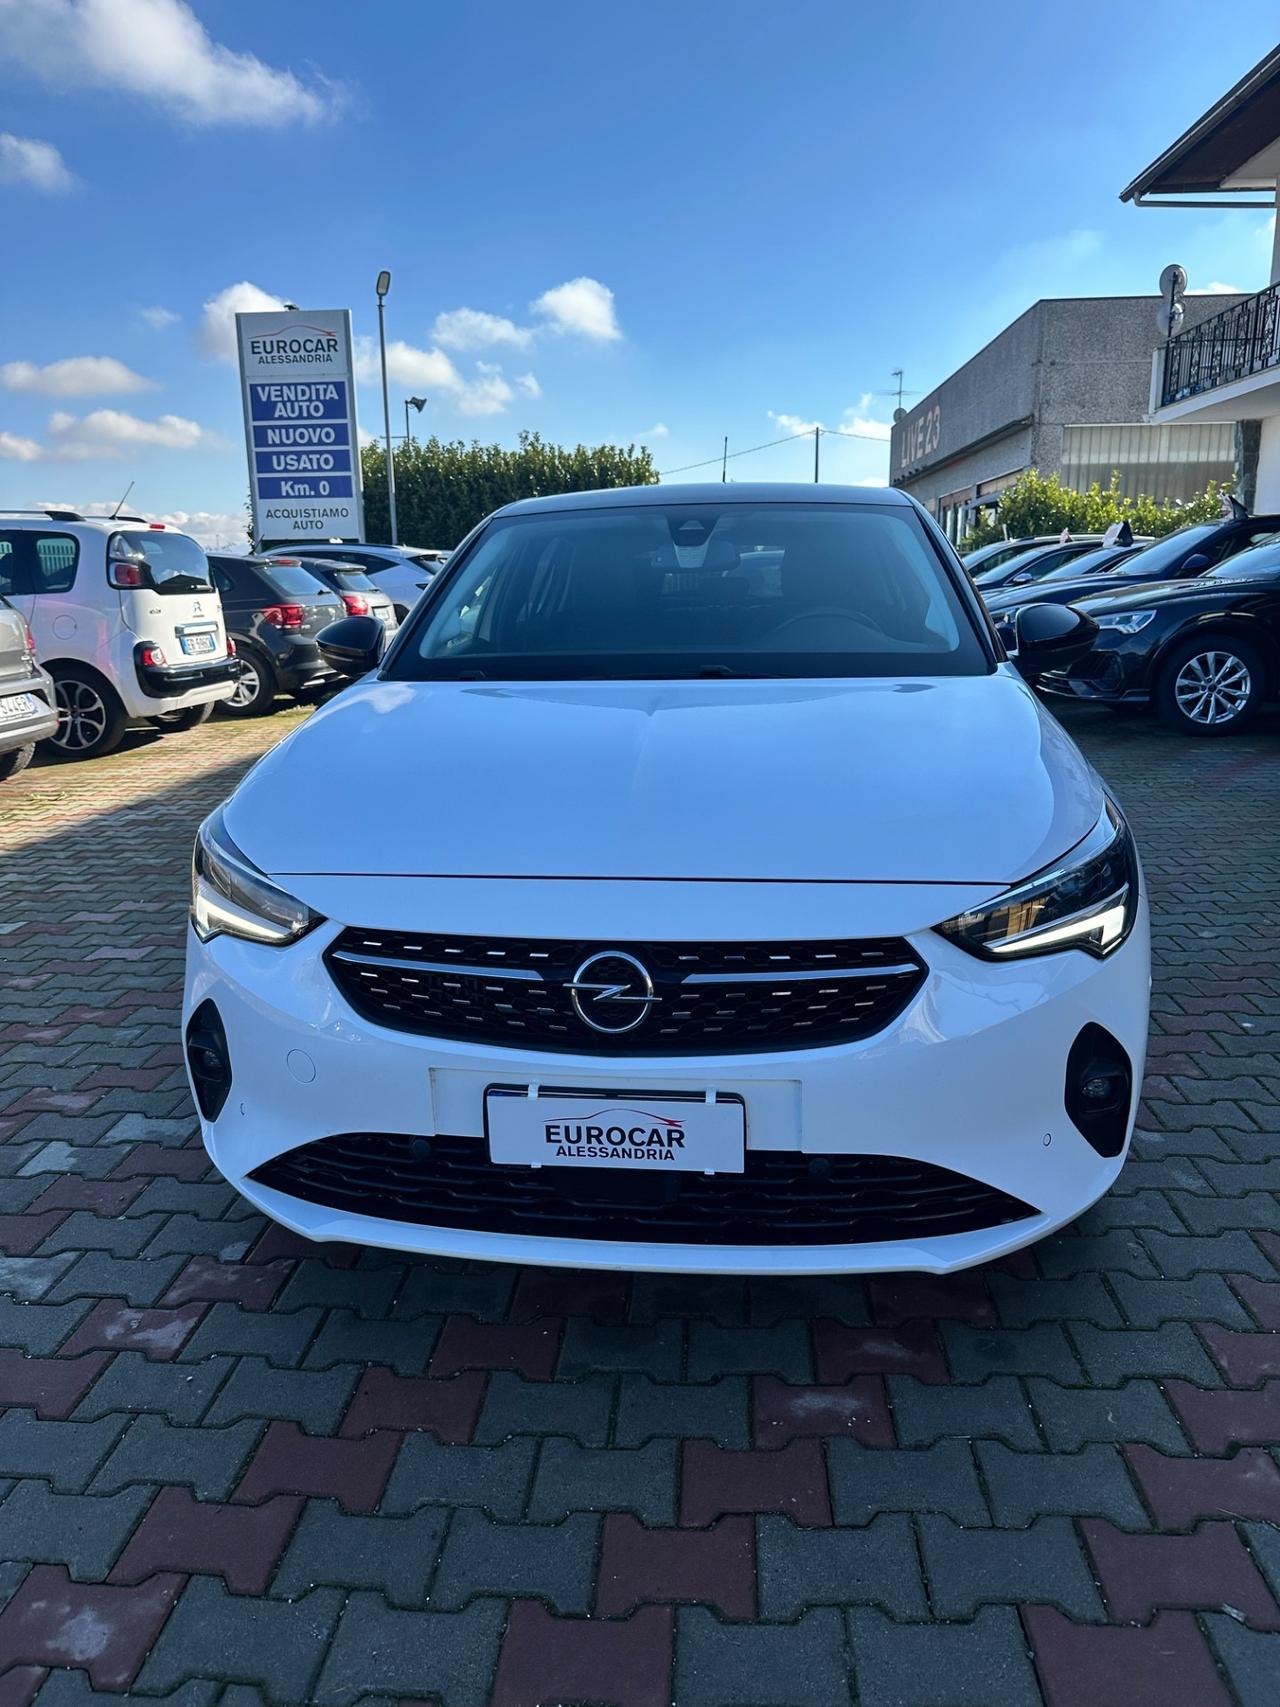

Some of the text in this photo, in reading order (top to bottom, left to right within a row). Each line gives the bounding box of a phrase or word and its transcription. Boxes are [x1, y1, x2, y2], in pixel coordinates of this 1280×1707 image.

[250, 338, 339, 354] EUROCAR
[258, 353, 333, 365] ALESSANDRIA
[257, 384, 338, 402] VENDITA
[274, 402, 324, 418] AUTO
[267, 427, 335, 445] NUOVO
[271, 453, 334, 471] USATO
[280, 480, 330, 497] Km. 0
[266, 507, 349, 519] ACQUISTIAMO
[292, 520, 324, 530] AUTO
[544, 1124, 685, 1149] EUROCAR
[555, 1145, 675, 1161] ALESSANDRIA
